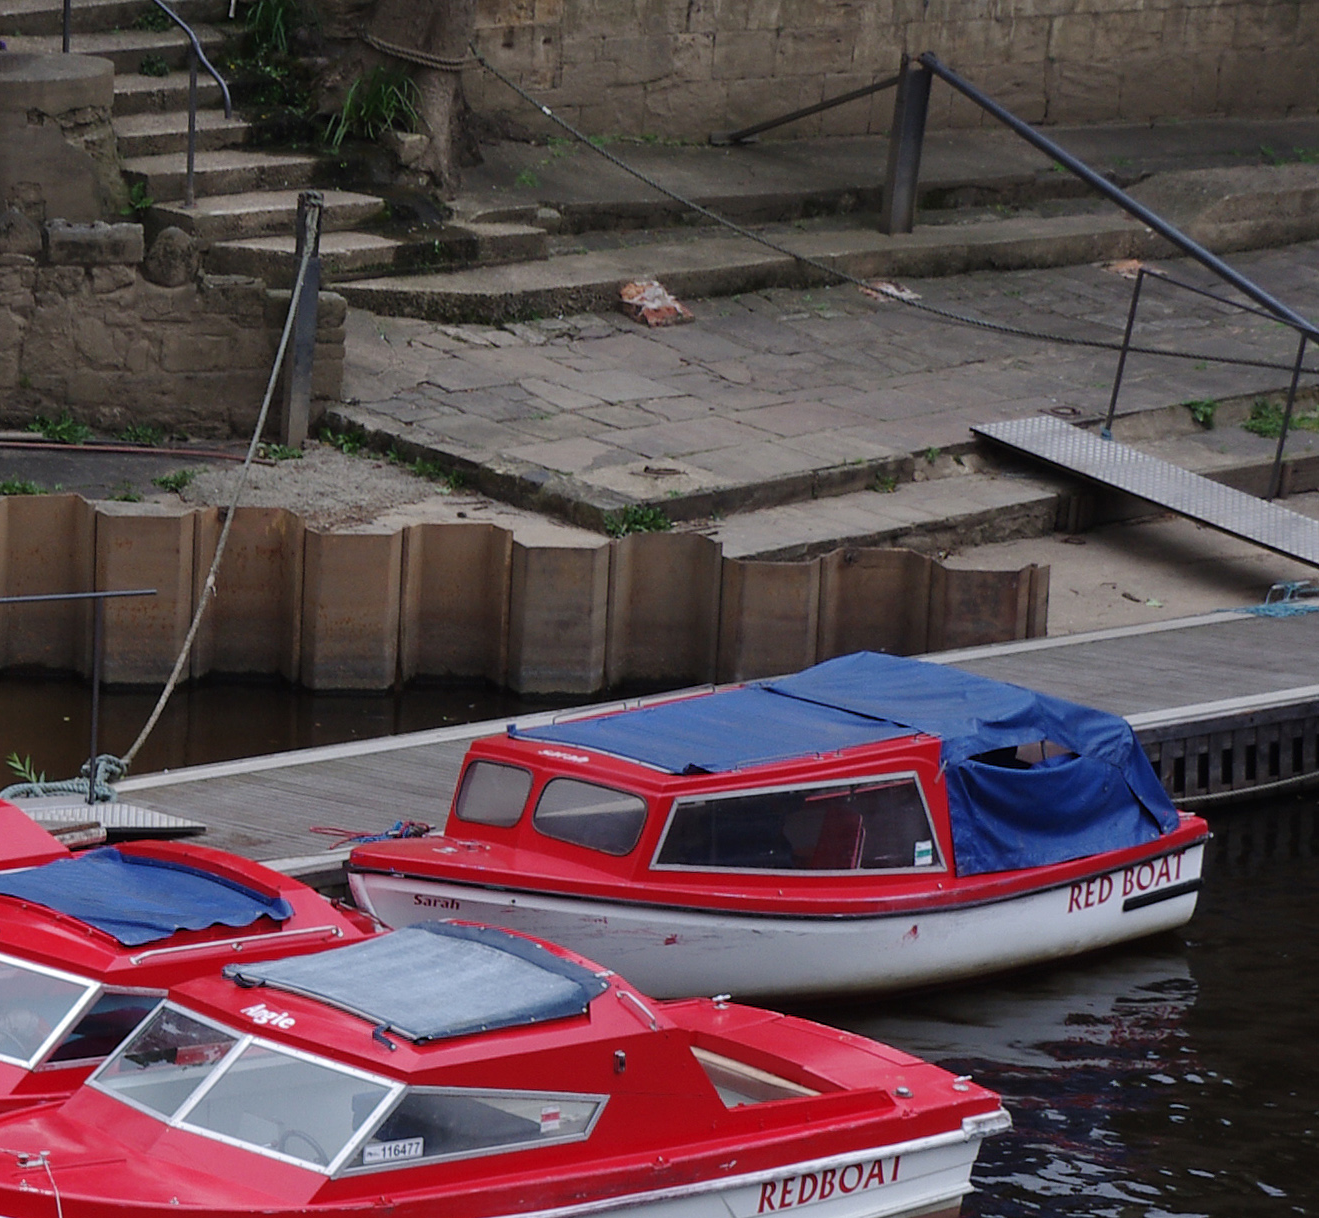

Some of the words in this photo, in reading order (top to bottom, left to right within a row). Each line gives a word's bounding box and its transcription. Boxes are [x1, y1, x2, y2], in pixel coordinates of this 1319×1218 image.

[1068, 872, 1113, 913] RED
[1122, 850, 1186, 897] BOAT
[413, 894, 461, 910] Sarah
[239, 1003, 296, 1029] Angie
[381, 1141, 421, 1159] 116477
[758, 1156, 901, 1213] REDBOAT
